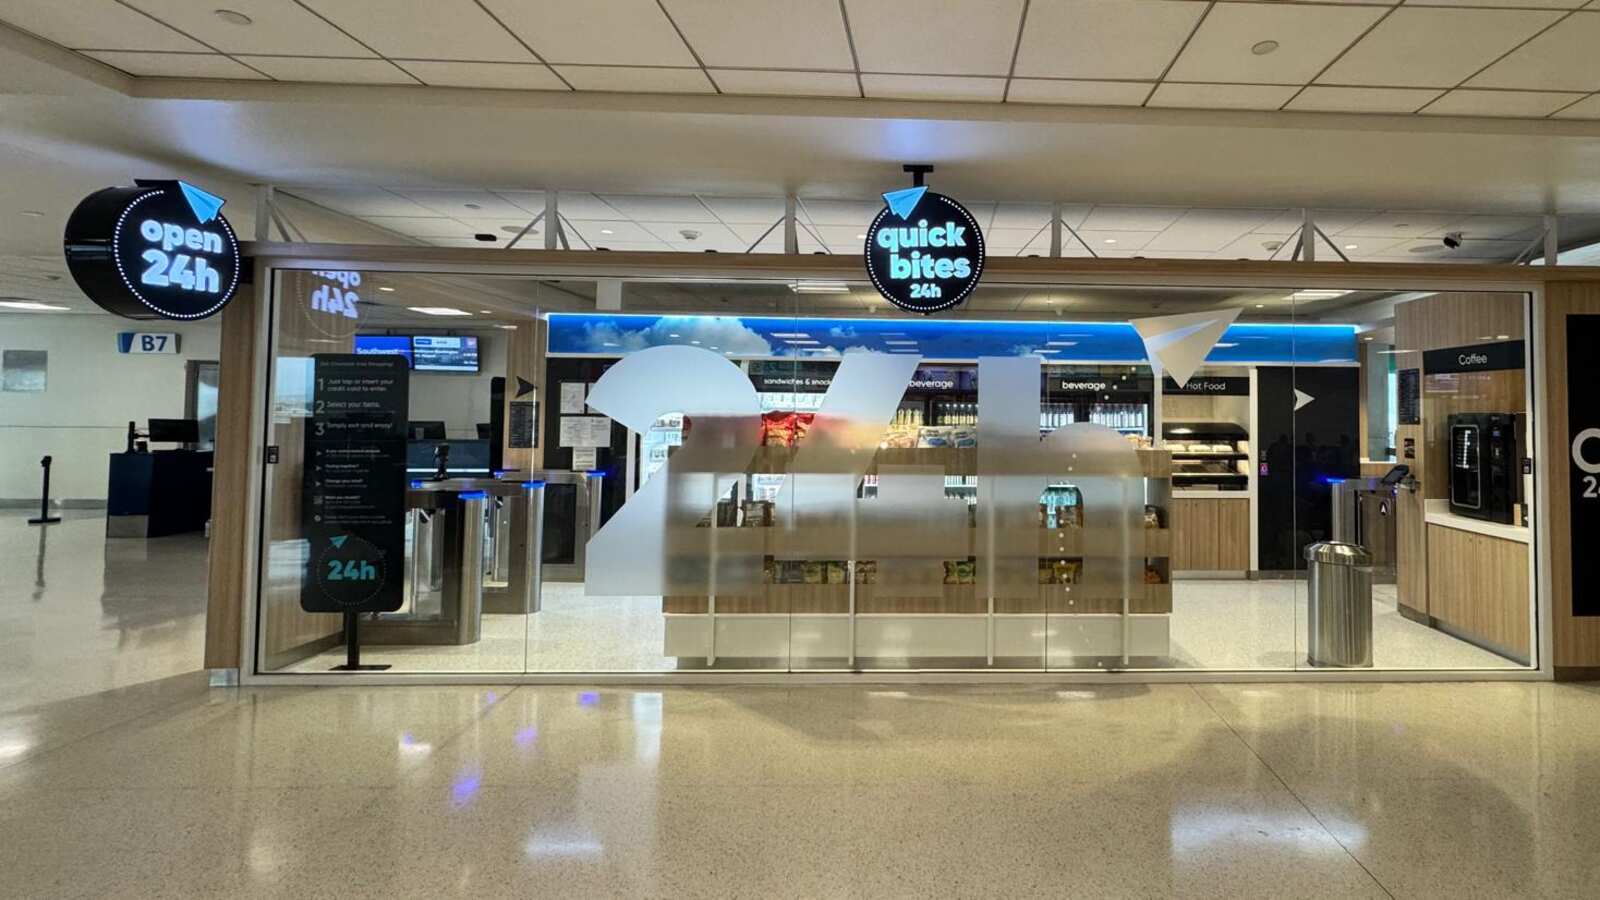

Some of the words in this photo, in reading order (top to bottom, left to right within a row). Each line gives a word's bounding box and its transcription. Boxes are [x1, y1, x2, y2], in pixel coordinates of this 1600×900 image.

[141, 219, 222, 254] open
[877, 219, 967, 252] quick
[141, 248, 220, 293] 24h
[889, 250, 971, 279] bites
[909, 283, 942, 298] 24h
[141, 335, 168, 352] B7
[1458, 353, 1488, 366] Coffee
[317, 377, 324, 392] 1
[380, 379, 394, 388] your
[1061, 380, 1106, 390] beverage
[1186, 382, 1202, 391] Hot
[1203, 381, 1226, 391] Food
[315, 400, 325, 415] 2
[348, 401, 361, 409] your
[315, 421, 325, 437] 3
[327, 559, 376, 580] 24h
